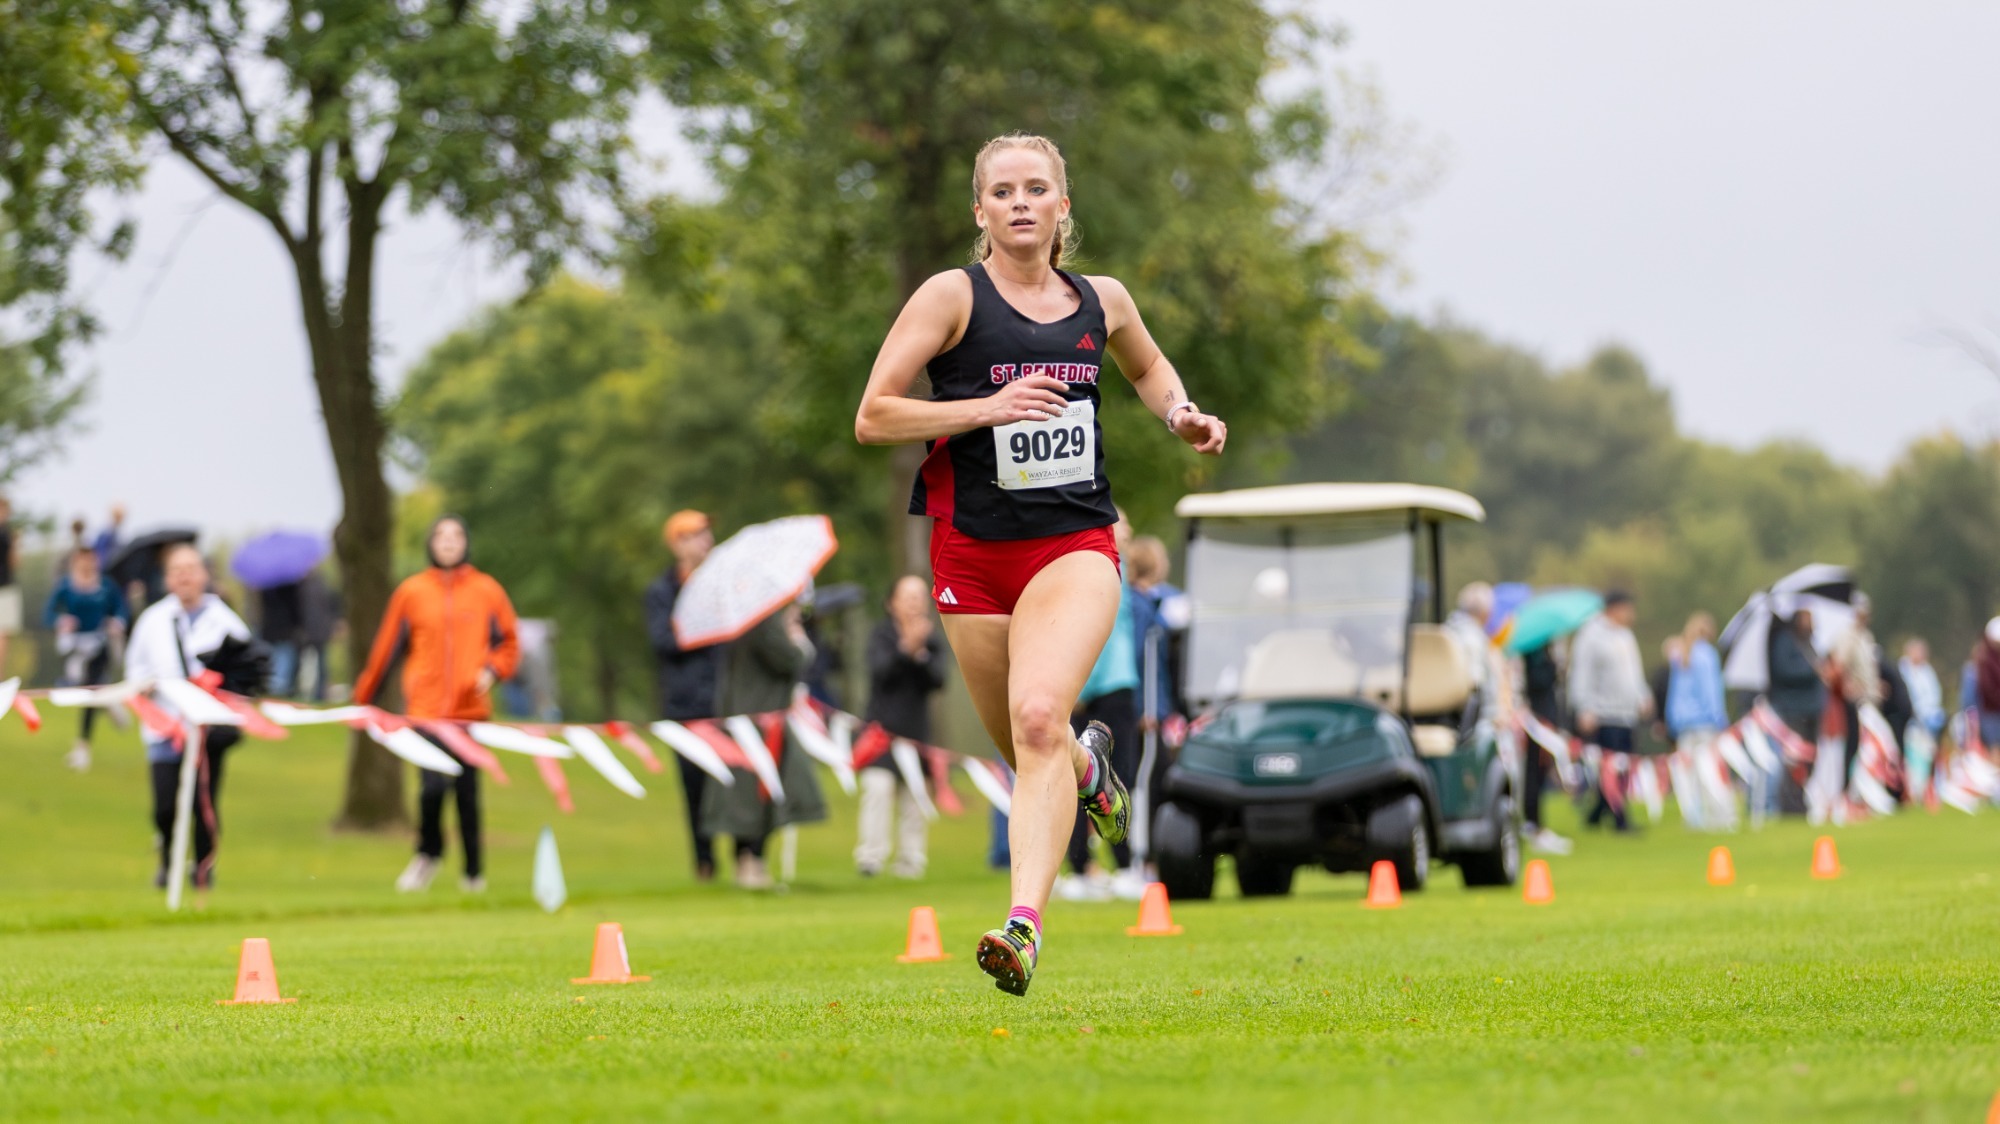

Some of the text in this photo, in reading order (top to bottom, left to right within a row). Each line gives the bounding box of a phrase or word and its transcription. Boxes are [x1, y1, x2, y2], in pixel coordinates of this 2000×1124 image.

[1010, 426, 1085, 464] 9029
[1028, 469, 1059, 479] WAYZATA
[1060, 466, 1082, 475] RESULTS
